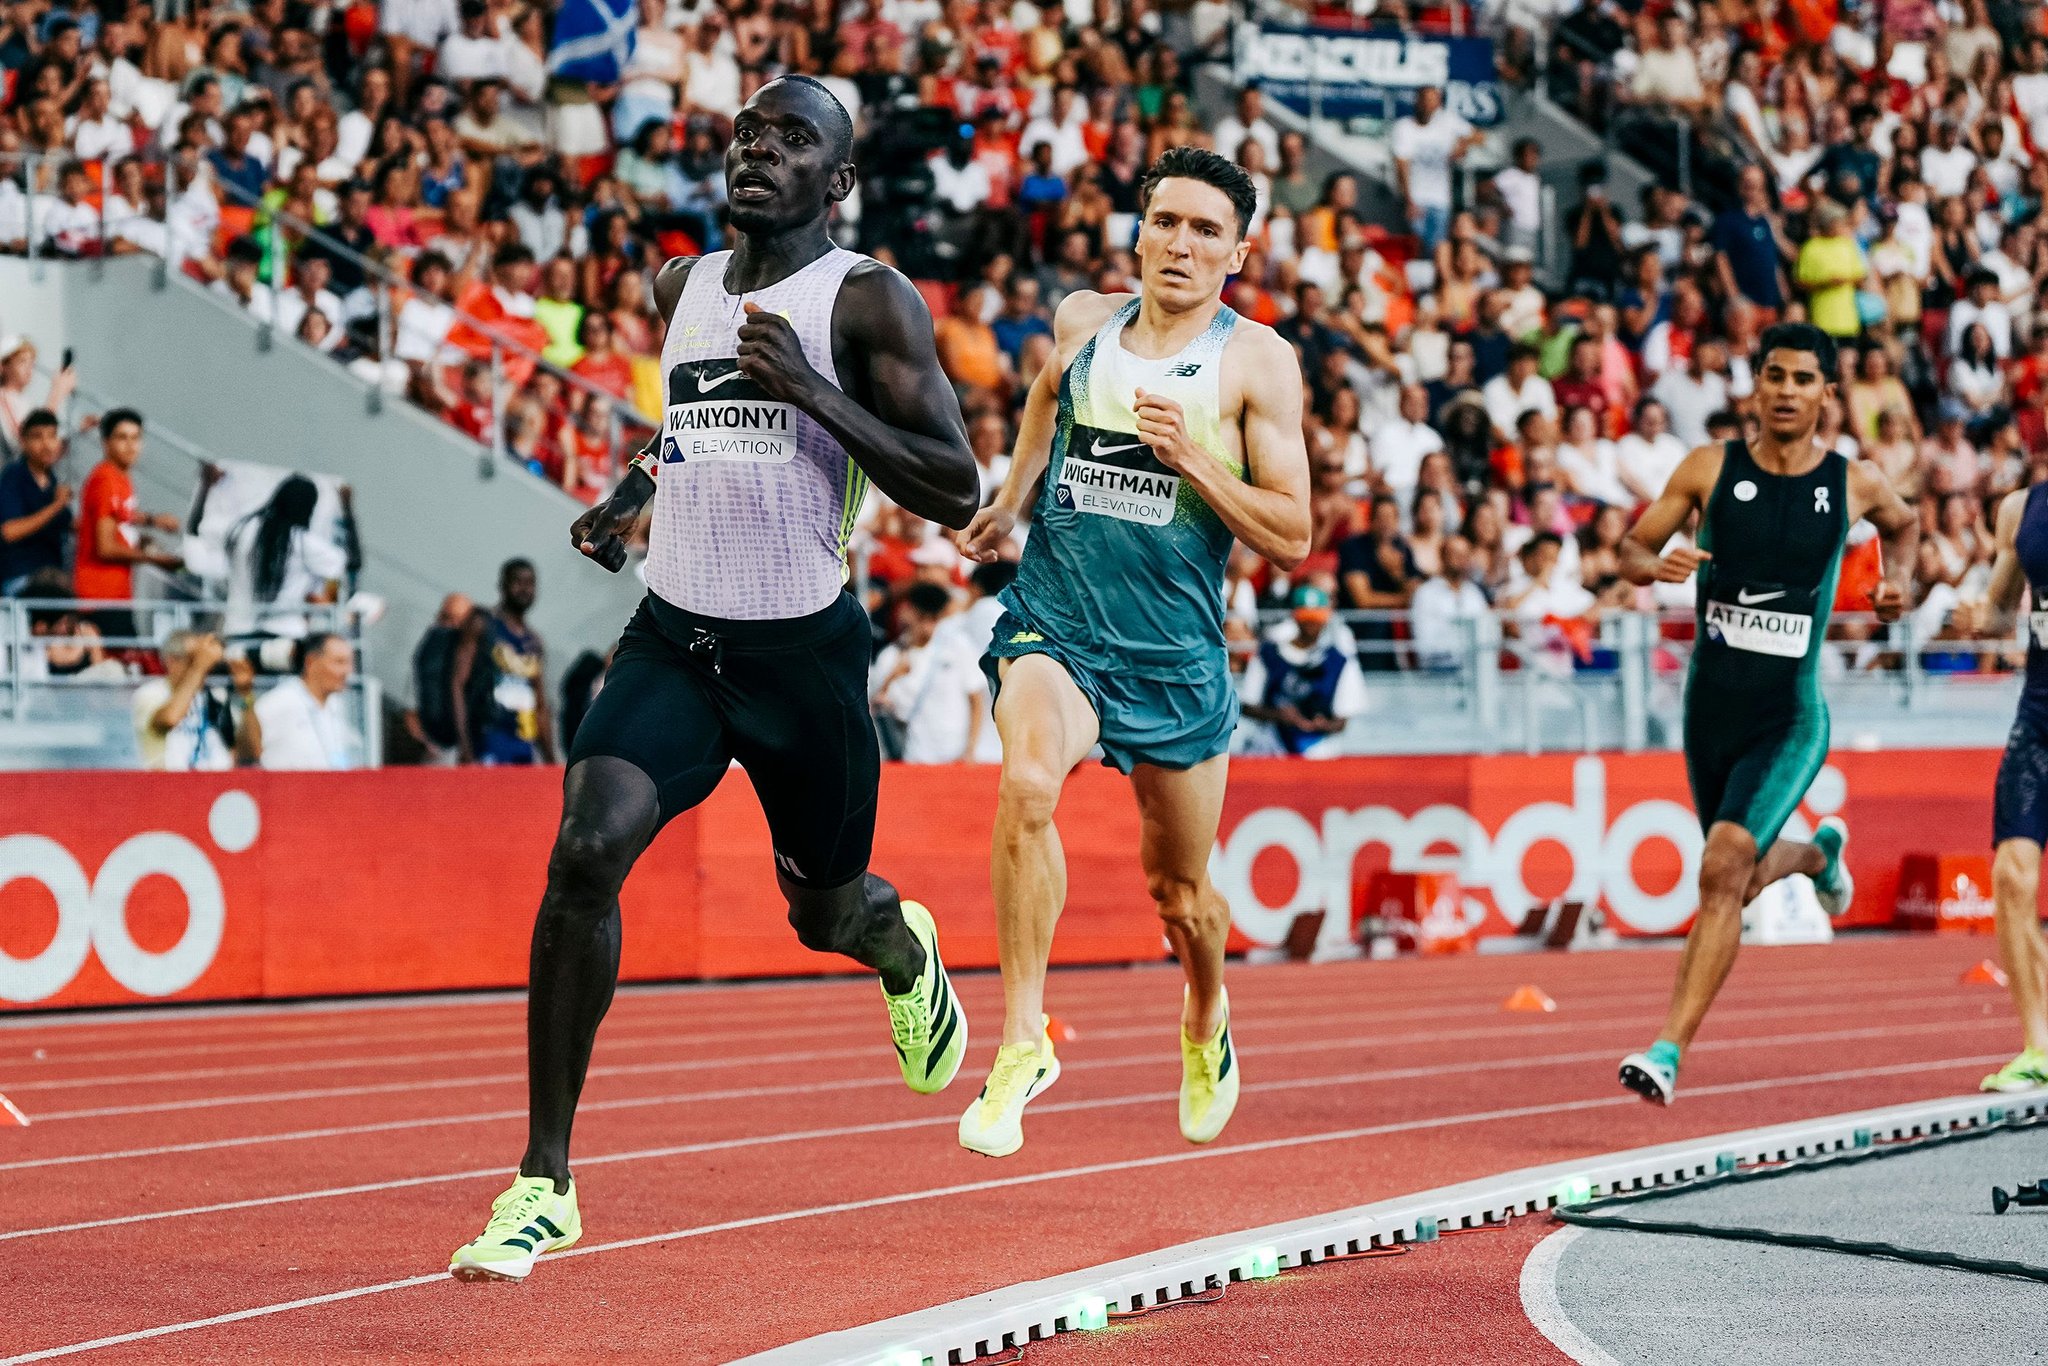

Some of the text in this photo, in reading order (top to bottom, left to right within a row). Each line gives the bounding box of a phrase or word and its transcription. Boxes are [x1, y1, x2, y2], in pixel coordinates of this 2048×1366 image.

[669, 406, 788, 432] WANYONYI
[692, 438, 783, 456] ELEVATION
[1063, 462, 1174, 499] WIGHTMAN
[1081, 494, 1163, 519] ELEVATION
[1710, 605, 1804, 636] ATTAOUI
